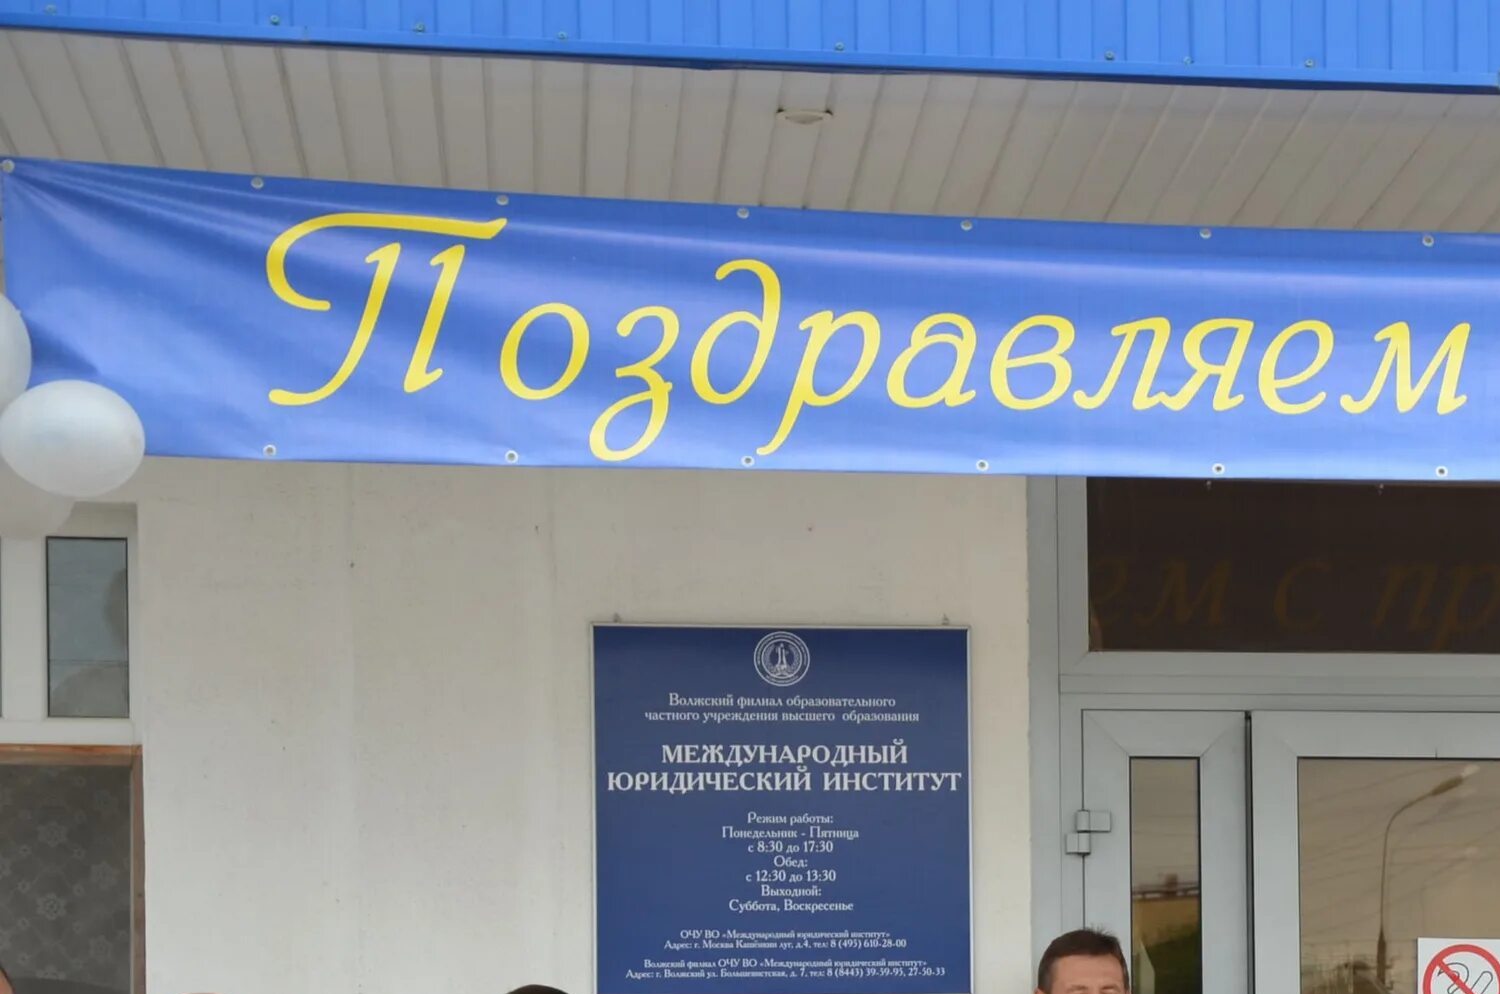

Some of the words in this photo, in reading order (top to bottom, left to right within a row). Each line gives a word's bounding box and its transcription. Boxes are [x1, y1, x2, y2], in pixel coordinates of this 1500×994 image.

[267, 213, 1470, 460] Поздравляем
[669, 693, 734, 706] Волжский
[737, 695, 783, 709] филиал
[786, 695, 896, 709] образовательного
[645, 710, 700, 721] частного
[702, 710, 778, 723] учреждения
[782, 711, 835, 721] высшего
[842, 710, 920, 724] образования
[661, 738, 908, 767] МЕЖДУНАРОДНЫЙ
[607, 765, 812, 794] ЮРИДИЧЕСКИЙ
[823, 772, 962, 791] ИНСТИТУТ
[747, 811, 787, 824] Режим
[790, 813, 834, 826] работы:
[722, 826, 798, 839] Понедельник
[810, 826, 859, 840] Пятница
[748, 844, 754, 852] с
[757, 841, 783, 852] 8:30
[786, 844, 800, 853] до
[803, 841, 834, 853] 17:30
[773, 855, 808, 868] Обед:
[746, 873, 752, 882] с
[756, 870, 786, 882] 12:30
[789, 873, 803, 883] до
[807, 870, 836, 882] 13:30
[761, 884, 822, 898] Выходной:
[729, 899, 780, 914] Суббота,
[784, 899, 854, 913] Воскресенье
[680, 930, 702, 939] ОЧУ
[704, 930, 720, 939] ВО
[722, 929, 795, 940] «Международный
[797, 930, 849, 940] юридический
[664, 940, 692, 950] Адрес:
[703, 940, 734, 949] Москва
[830, 939, 837, 948] 8
[838, 939, 862, 949] (495)
[863, 939, 907, 949] 610-28-00
[644, 959, 685, 968] Волжский
[687, 960, 716, 970] филиал
[718, 958, 741, 968] ОЧУ
[742, 958, 757, 967] ВО
[760, 958, 832, 970] «Международный
[834, 959, 886, 968] юридический
[625, 969, 654, 979] Адрес:
[656, 970, 662, 978] г.
[664, 968, 705, 978] Волжский
[707, 971, 718, 979] ул.
[790, 970, 798, 978] д.
[827, 967, 833, 977] 8
[834, 967, 863, 978] (8443)
[908, 967, 946, 977] 27-50-33
